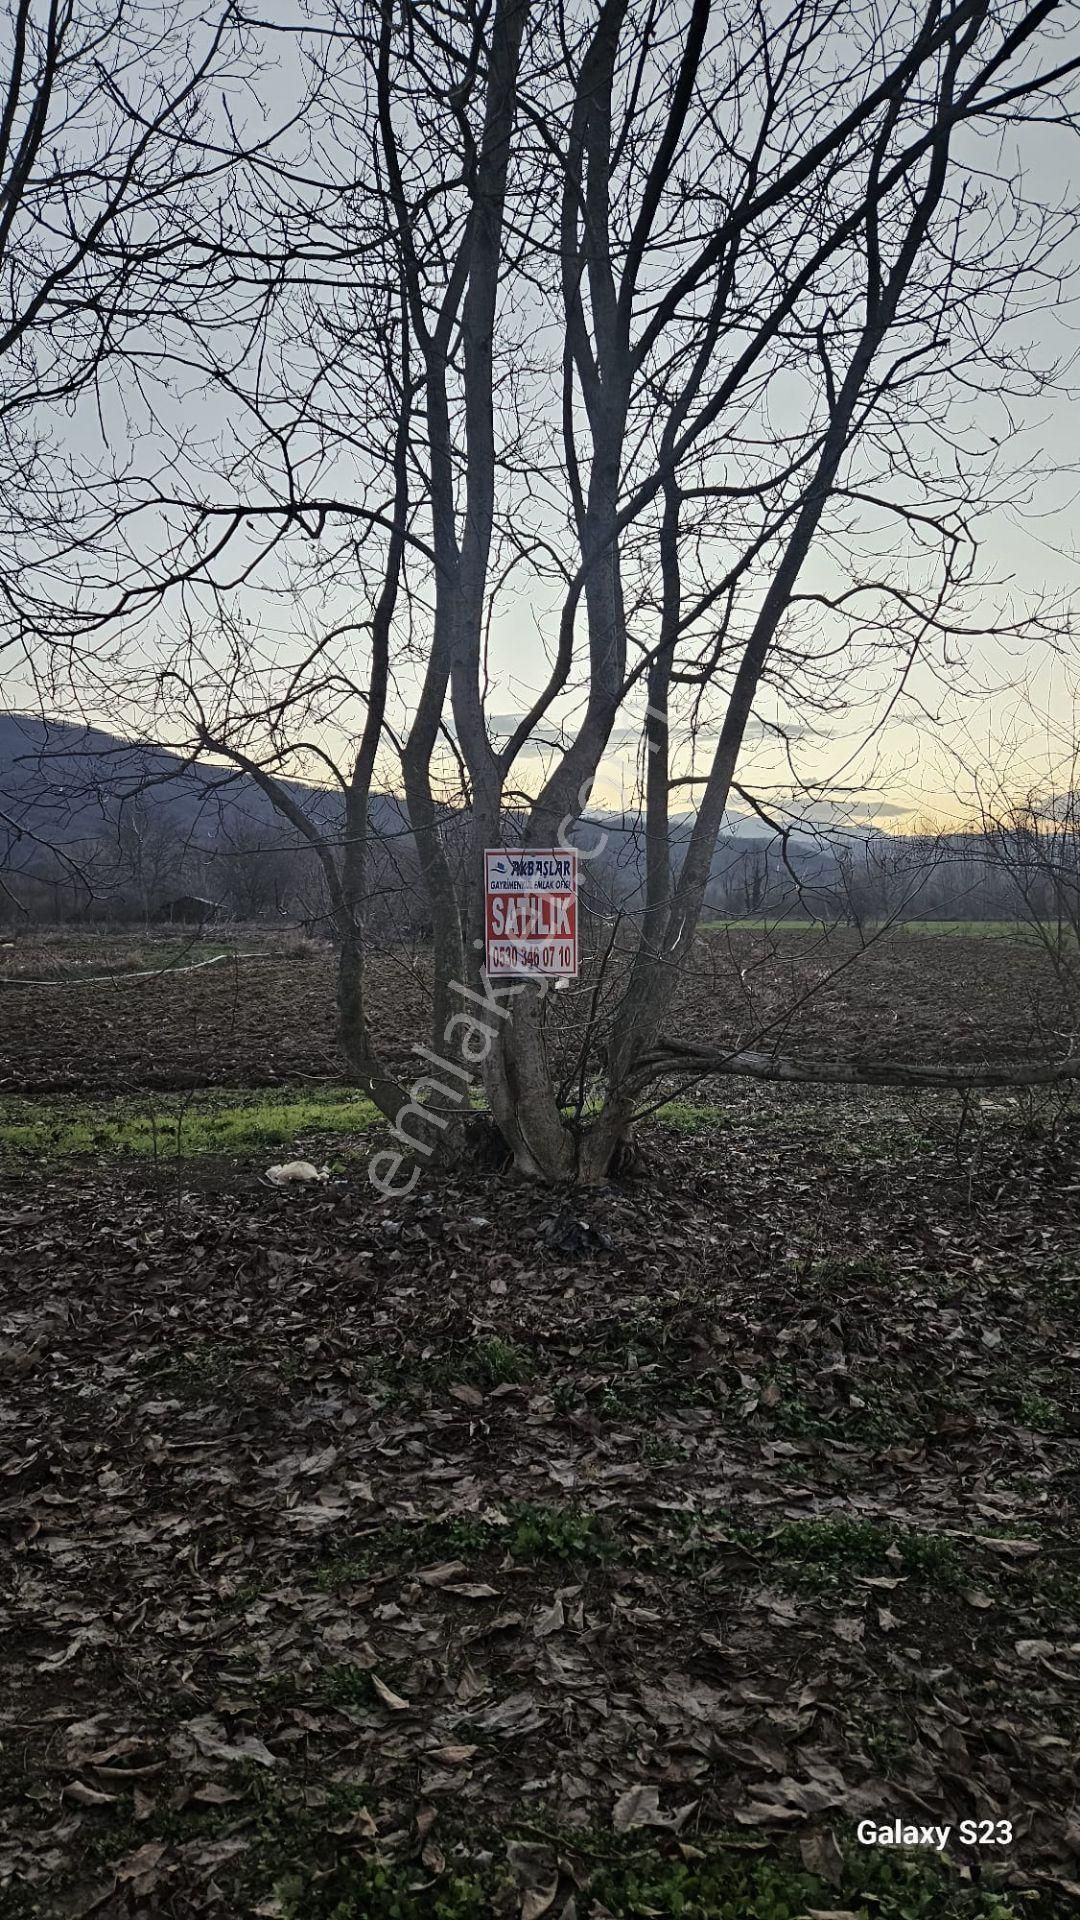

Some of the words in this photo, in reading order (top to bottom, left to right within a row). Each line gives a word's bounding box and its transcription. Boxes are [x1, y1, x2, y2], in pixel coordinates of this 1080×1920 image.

[511, 860, 571, 878] AKBAŞLAR
[490, 878, 533, 890] GAYRİMENK
[534, 880, 554, 890] EMLAK
[492, 897, 571, 936] SATILIK
[493, 946, 518, 967] 0530
[542, 946, 555, 967] 07
[558, 946, 571, 967] 10
